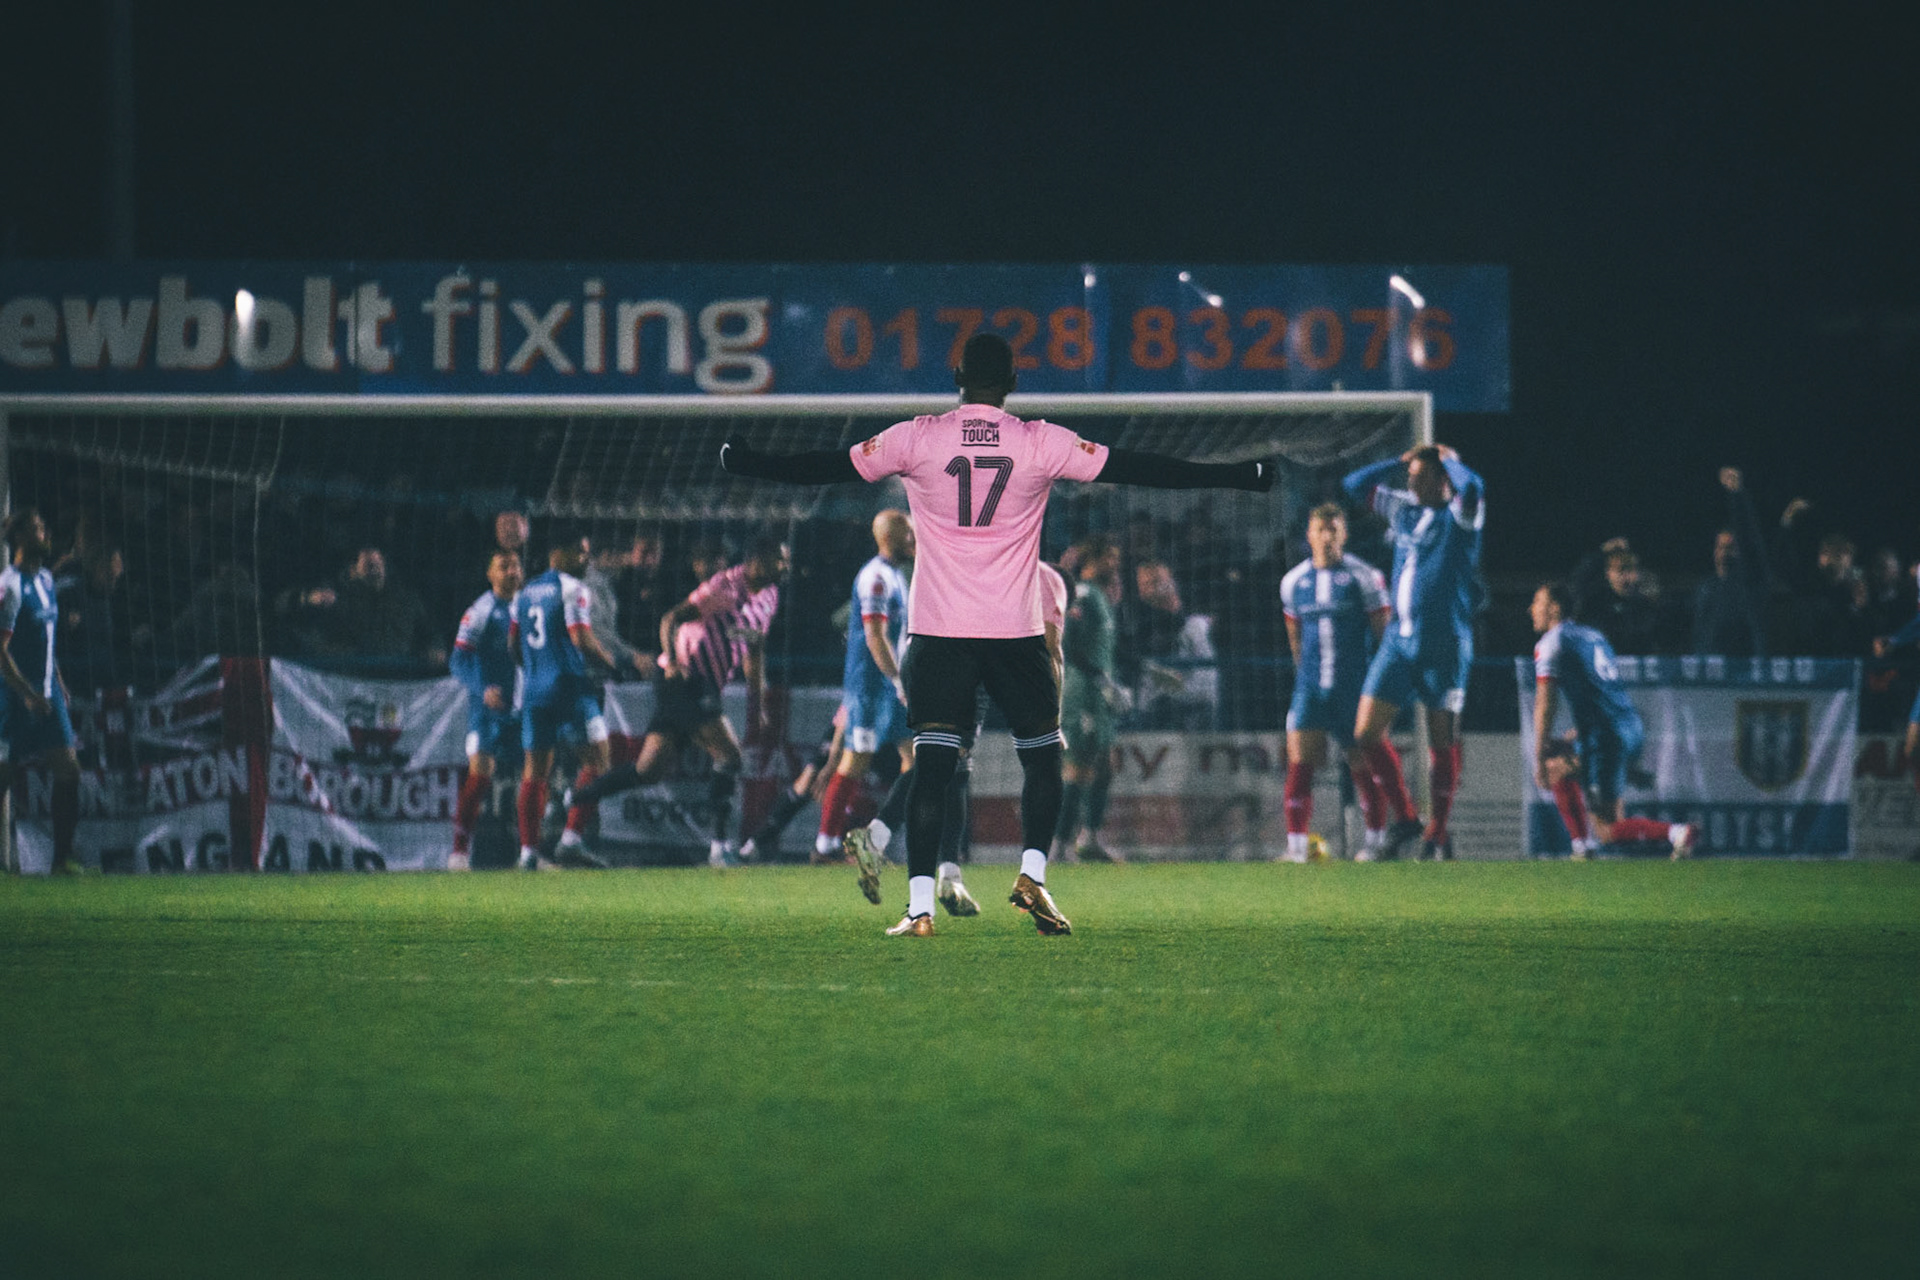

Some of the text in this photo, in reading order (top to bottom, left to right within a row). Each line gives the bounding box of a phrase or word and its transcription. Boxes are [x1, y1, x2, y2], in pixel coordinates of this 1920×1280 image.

[0, 274, 1456, 394] ewbolt fixing 01728 832076
[961, 429, 1000, 442] TOUCH
[943, 455, 1014, 527] 17
[527, 606, 546, 650] 3
[27, 746, 459, 819] NNATON BOROUGH
[102, 832, 387, 872] NGAND
